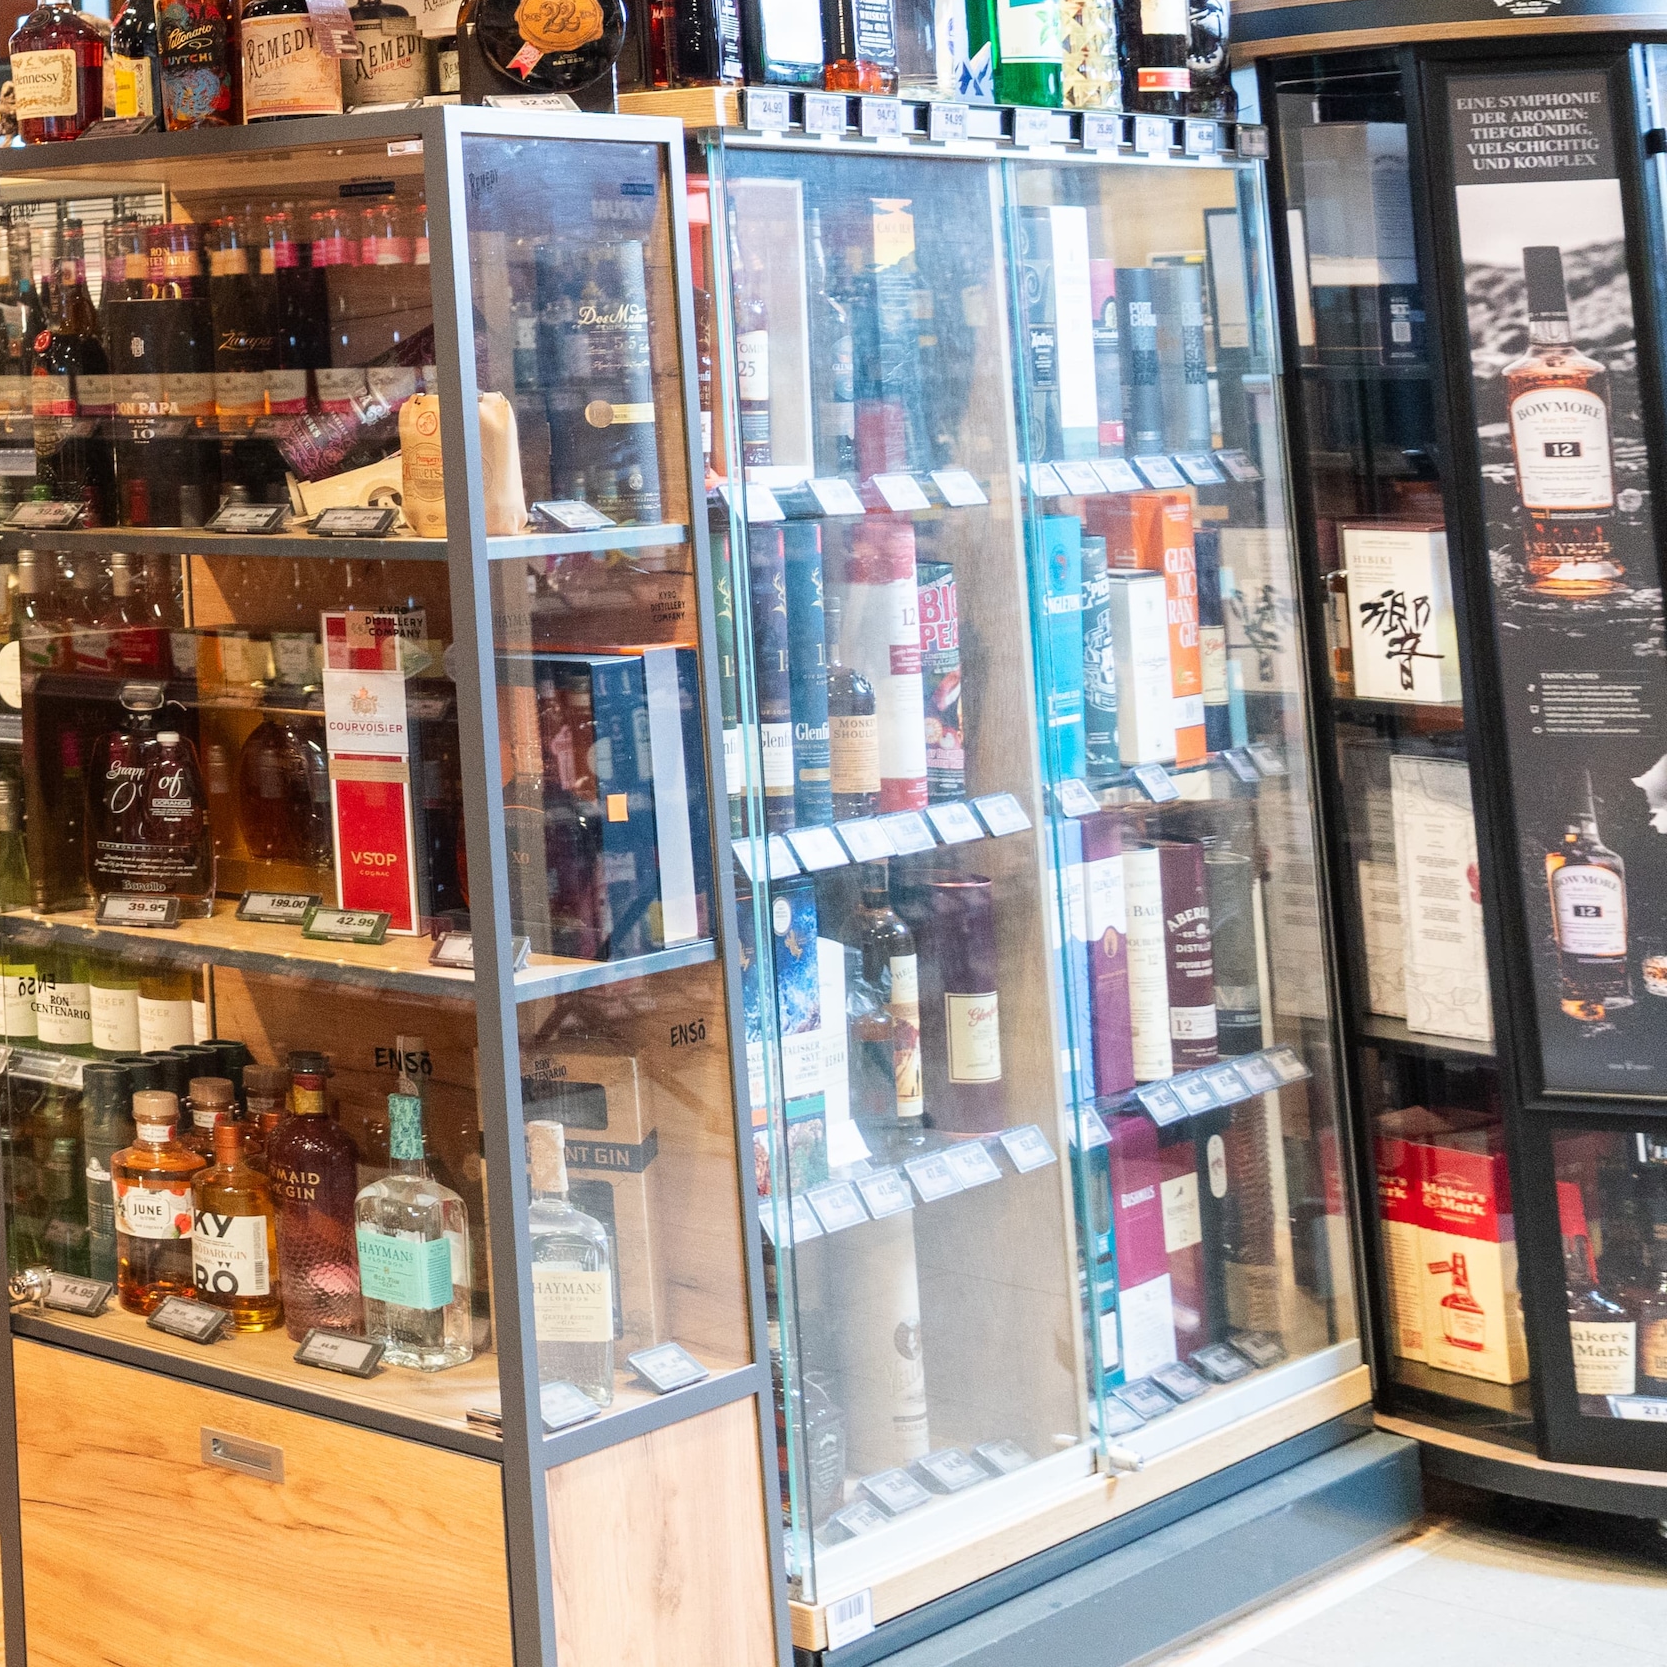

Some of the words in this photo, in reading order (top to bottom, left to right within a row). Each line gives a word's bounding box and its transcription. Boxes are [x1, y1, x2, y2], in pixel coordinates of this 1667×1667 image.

[1456, 97, 1497, 110] EINE
[1499, 91, 1602, 108] SYMPHONIE
[1472, 112, 1506, 125] DER
[1511, 108, 1589, 123] AROMEN:
[1467, 138, 1599, 156] VIELSCHICHTIG
[1473, 156, 1510, 170] UND
[1514, 153, 1597, 169] KOMPLEX
[738, 361, 756, 378] 25
[1516, 401, 1602, 421] BOWMORE
[132, 428, 155, 440] 10
[1552, 443, 1574, 457] 12
[1165, 547, 1196, 574] GLEN
[1353, 554, 1393, 566] HIBIKI
[1177, 572, 1198, 598] MO
[901, 607, 916, 627] 12
[1168, 597, 1198, 625] RAN
[364, 616, 424, 629] DISTILLERY
[368, 627, 422, 640] COMPANY
[1179, 622, 1199, 648] GIE
[1540, 671, 1572, 681] TASTING
[1573, 671, 1600, 681] NOTES
[329, 720, 403, 733] COURVOISIER
[158, 771, 184, 799] of
[350, 850, 398, 867] VSOP
[359, 869, 390, 877] COGNAC
[121, 878, 166, 893] Bonollo
[128, 902, 166, 913] 39.95
[269, 898, 307, 910] 199.00
[1579, 905, 1597, 918] 12
[335, 916, 375, 928] 42.99
[50, 995, 70, 1007] RON
[30, 1002, 91, 1021] CENTENARIO
[1175, 1018, 1192, 1033] 12
[594, 1148, 630, 1166] GIN
[286, 1184, 316, 1201] GIN
[1421, 1181, 1487, 1204] Maker's
[133, 1202, 163, 1216] JUNE
[1440, 1197, 1486, 1217] Mark
[229, 1250, 248, 1261] GIN
[62, 1282, 95, 1300] 14.95
[1576, 1344, 1630, 1358] Mark
